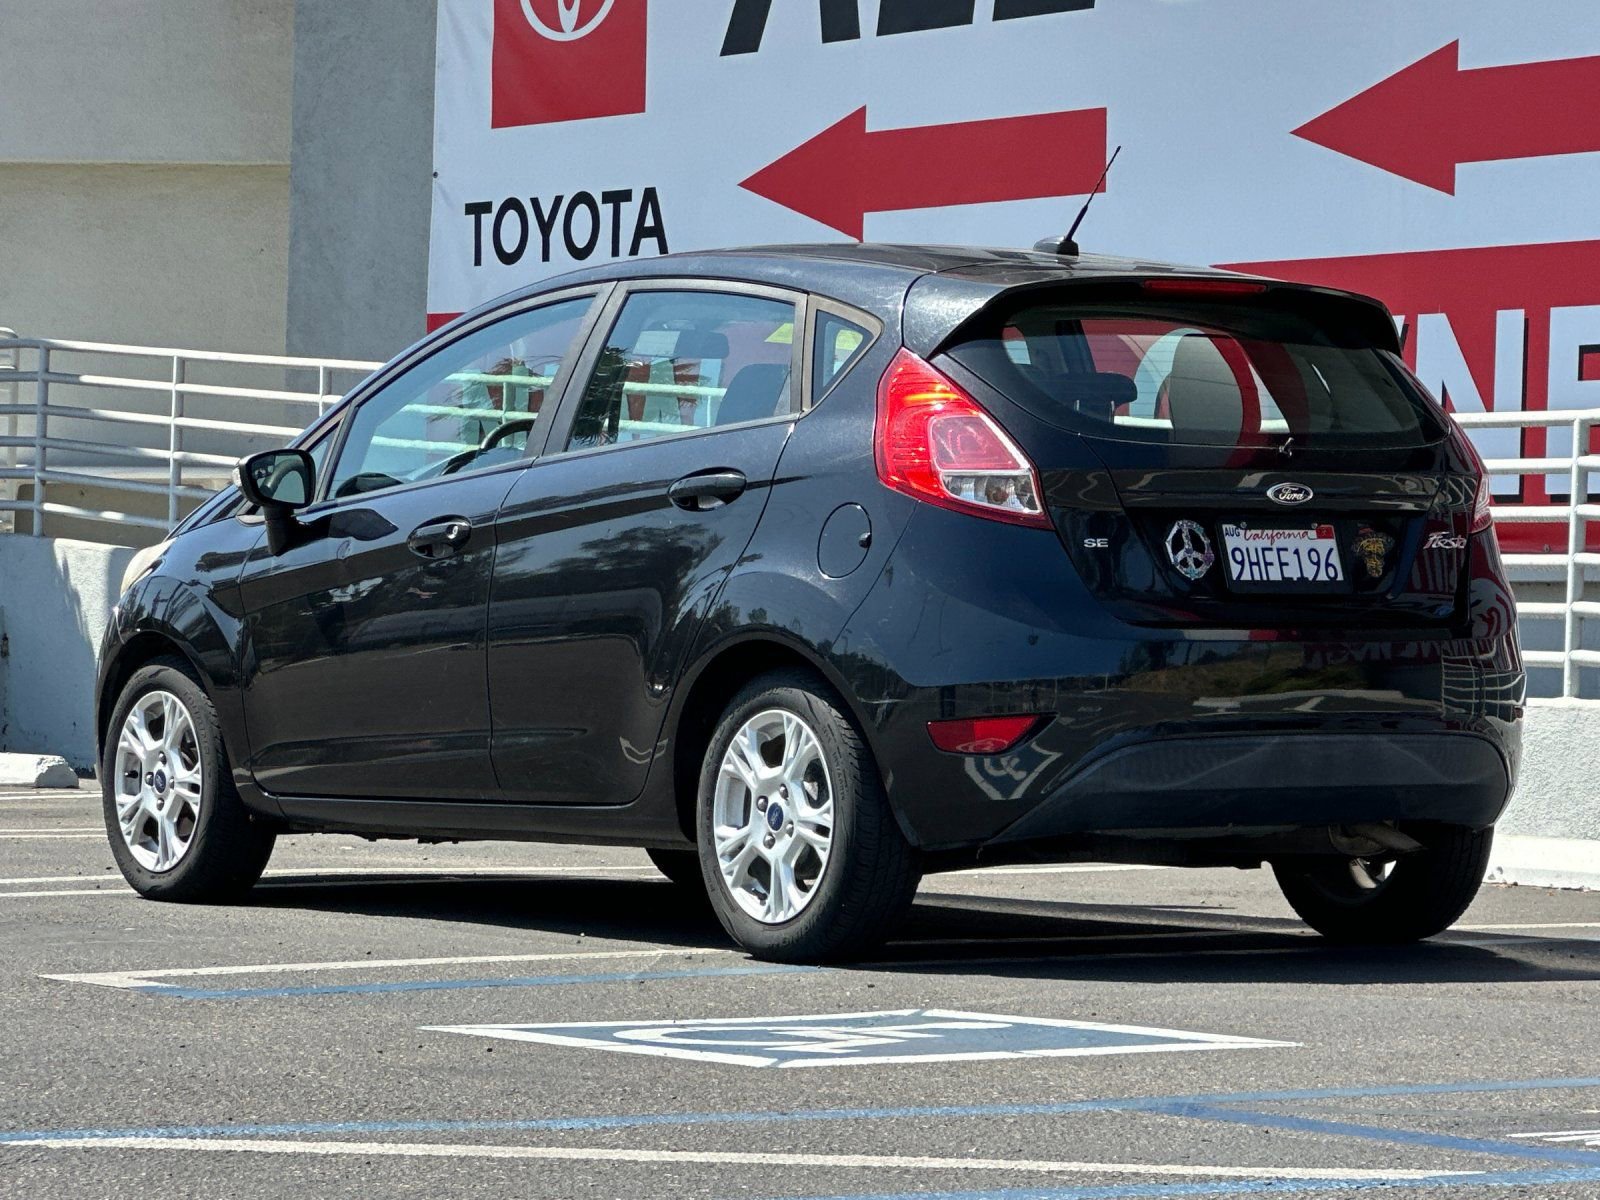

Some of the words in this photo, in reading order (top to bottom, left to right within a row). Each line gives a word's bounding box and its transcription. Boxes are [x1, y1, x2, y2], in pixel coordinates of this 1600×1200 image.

[464, 187, 669, 266] TOYOTA
[1224, 527, 1241, 537] AUG
[1243, 528, 1310, 546] California
[1083, 538, 1109, 548] SE
[1230, 547, 1340, 581] 9HFE196
